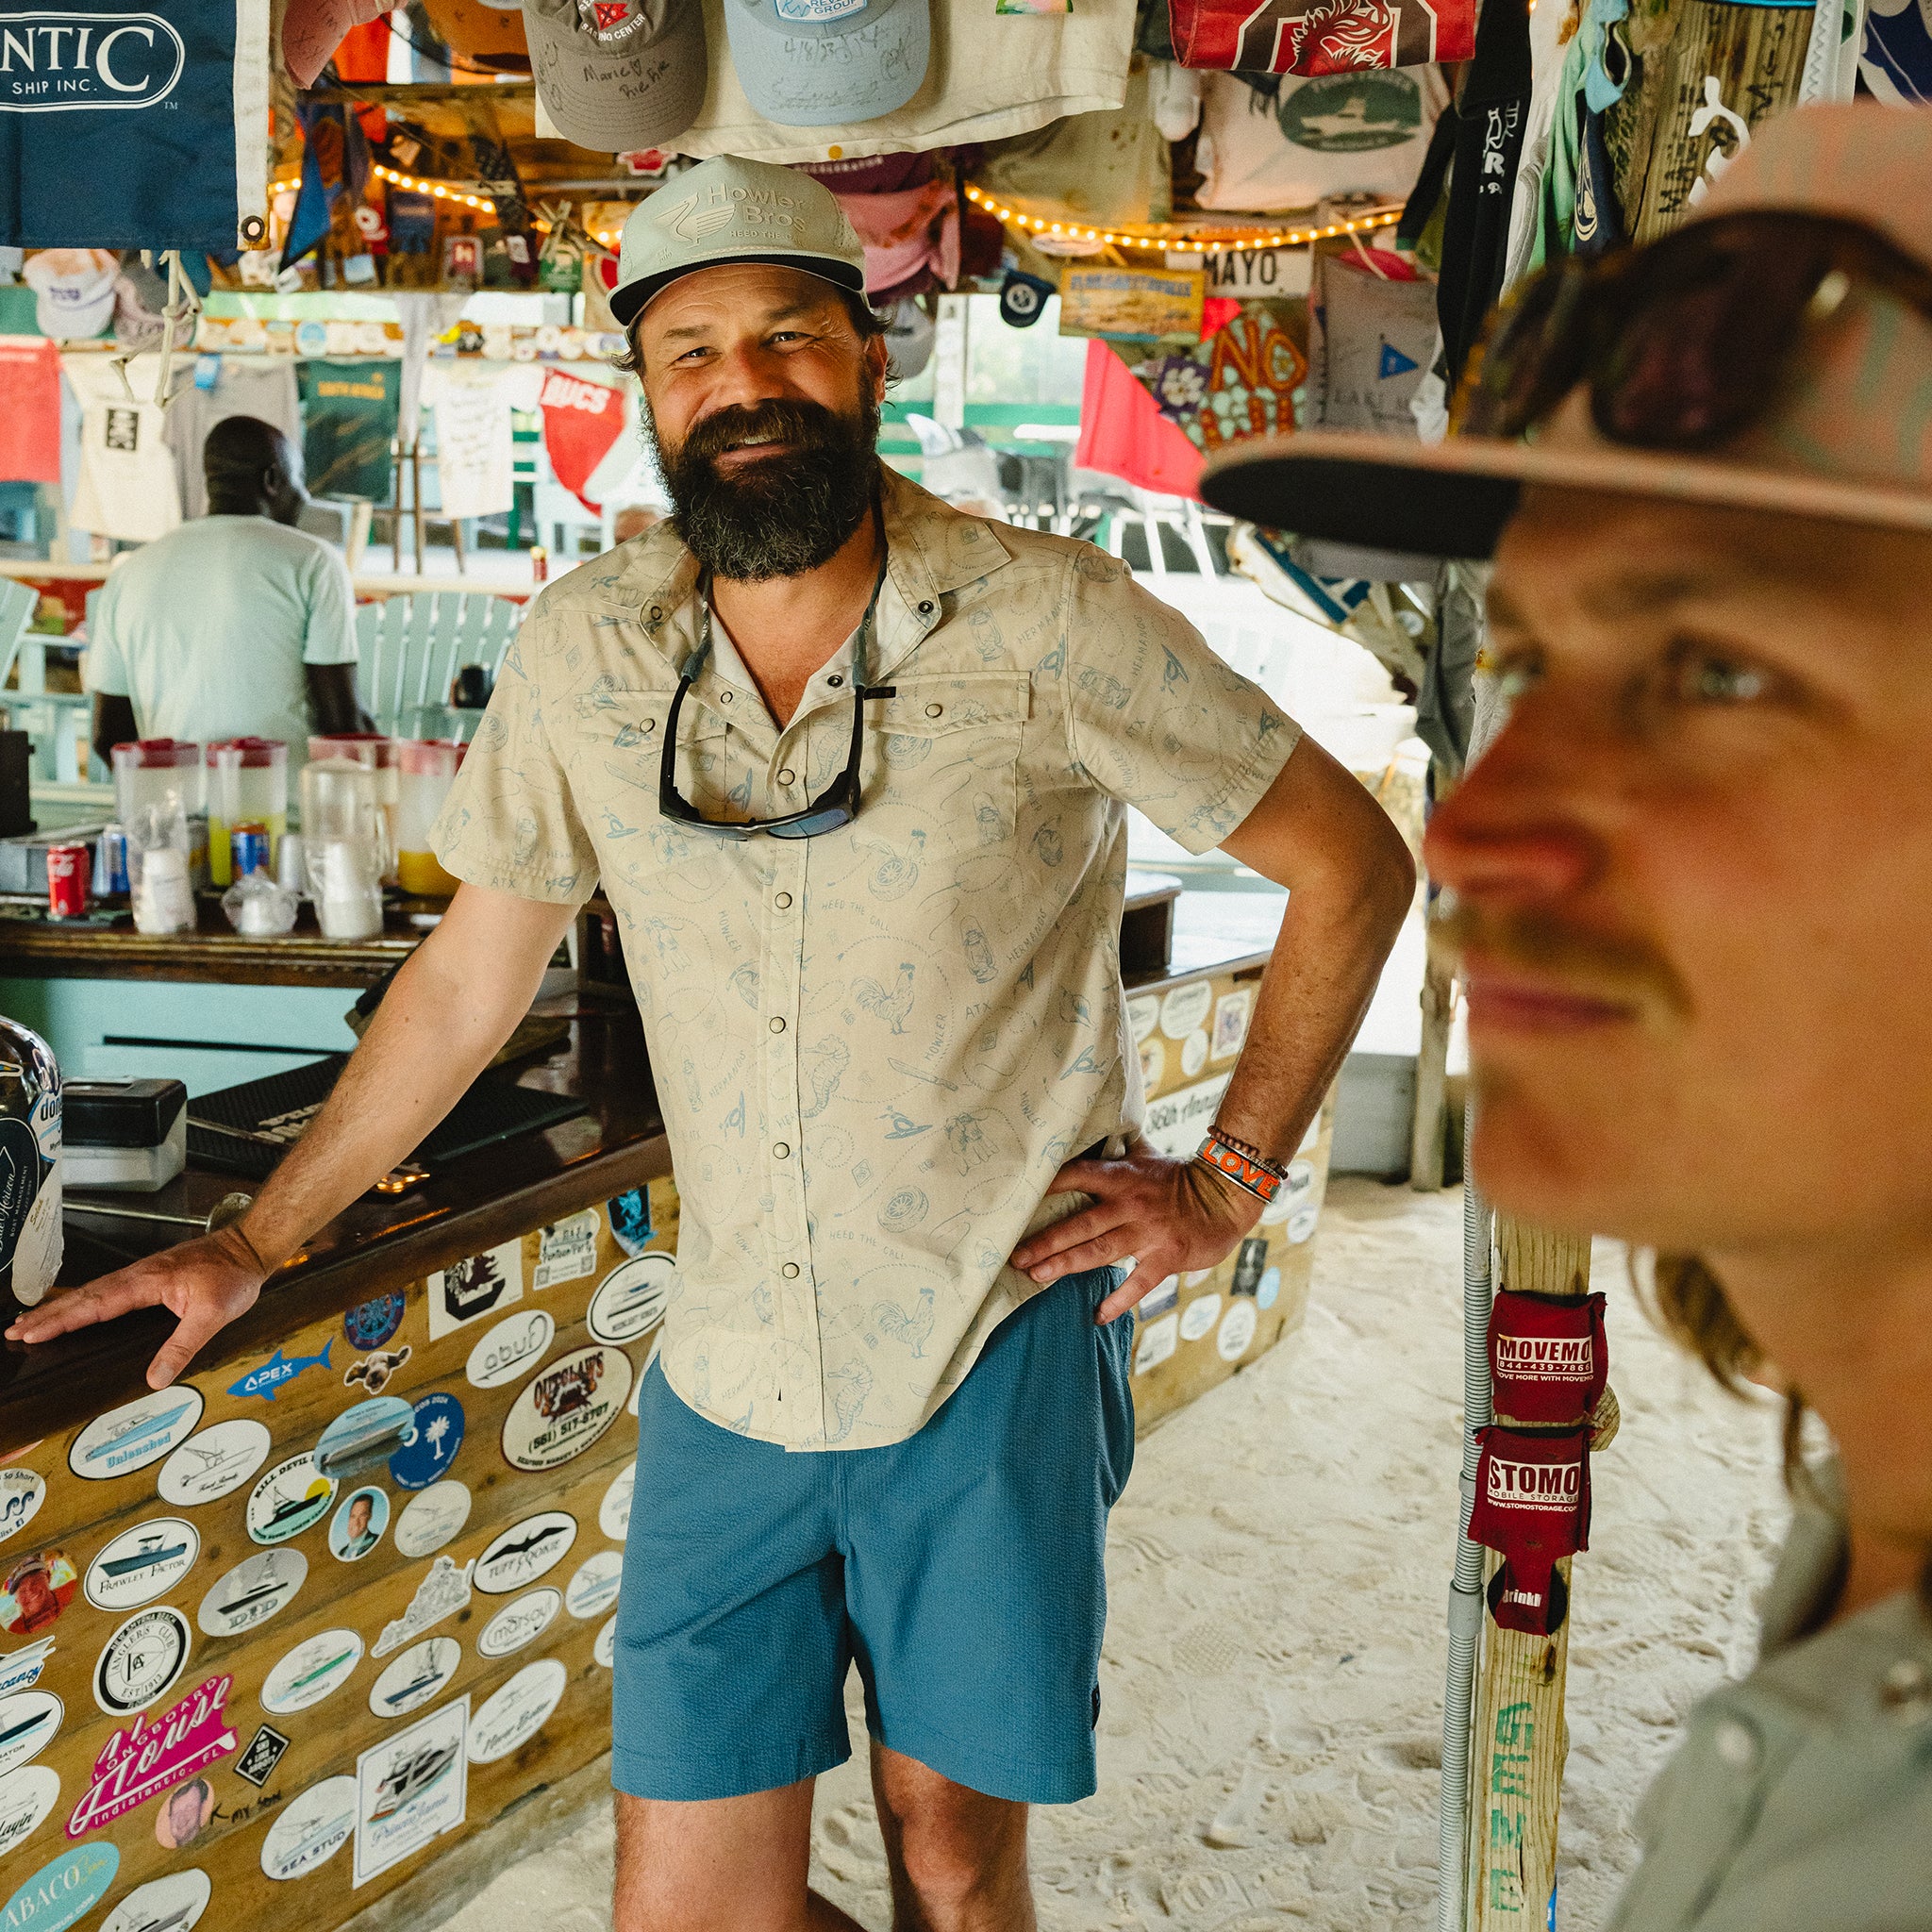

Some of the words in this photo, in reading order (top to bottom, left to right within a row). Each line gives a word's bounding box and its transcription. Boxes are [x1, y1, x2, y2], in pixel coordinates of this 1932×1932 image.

[614, 12, 646, 40] CENTER
[12, 81, 49, 94] SHIP
[58, 79, 97, 92] INC.
[709, 183, 804, 209] Howler
[744, 204, 806, 233] Bros
[1202, 251, 1277, 286] MAYO
[822, 900, 846, 911] HEED
[851, 899, 865, 915] THE
[869, 914, 891, 932] CALL
[718, 909, 742, 953] HOWLER
[924, 1012, 947, 1061] HOWLER
[1202, 1139, 1280, 1199] LOVE
[829, 1230, 854, 1242] HEED
[860, 1232, 876, 1246] THE
[882, 1245, 906, 1260] CALL
[1499, 1340, 1591, 1361] MOVEMO
[244, 1362, 292, 1391] APEX
[1499, 1360, 1591, 1372] 844-439-7866
[1562, 1374, 1594, 1383] MOVEMO
[1490, 1459, 1580, 1494] STOMO
[94, 1677, 217, 1782] LONGBOARD
[202, 1749, 219, 1764] FL
[280, 1856, 308, 1876] SEA
